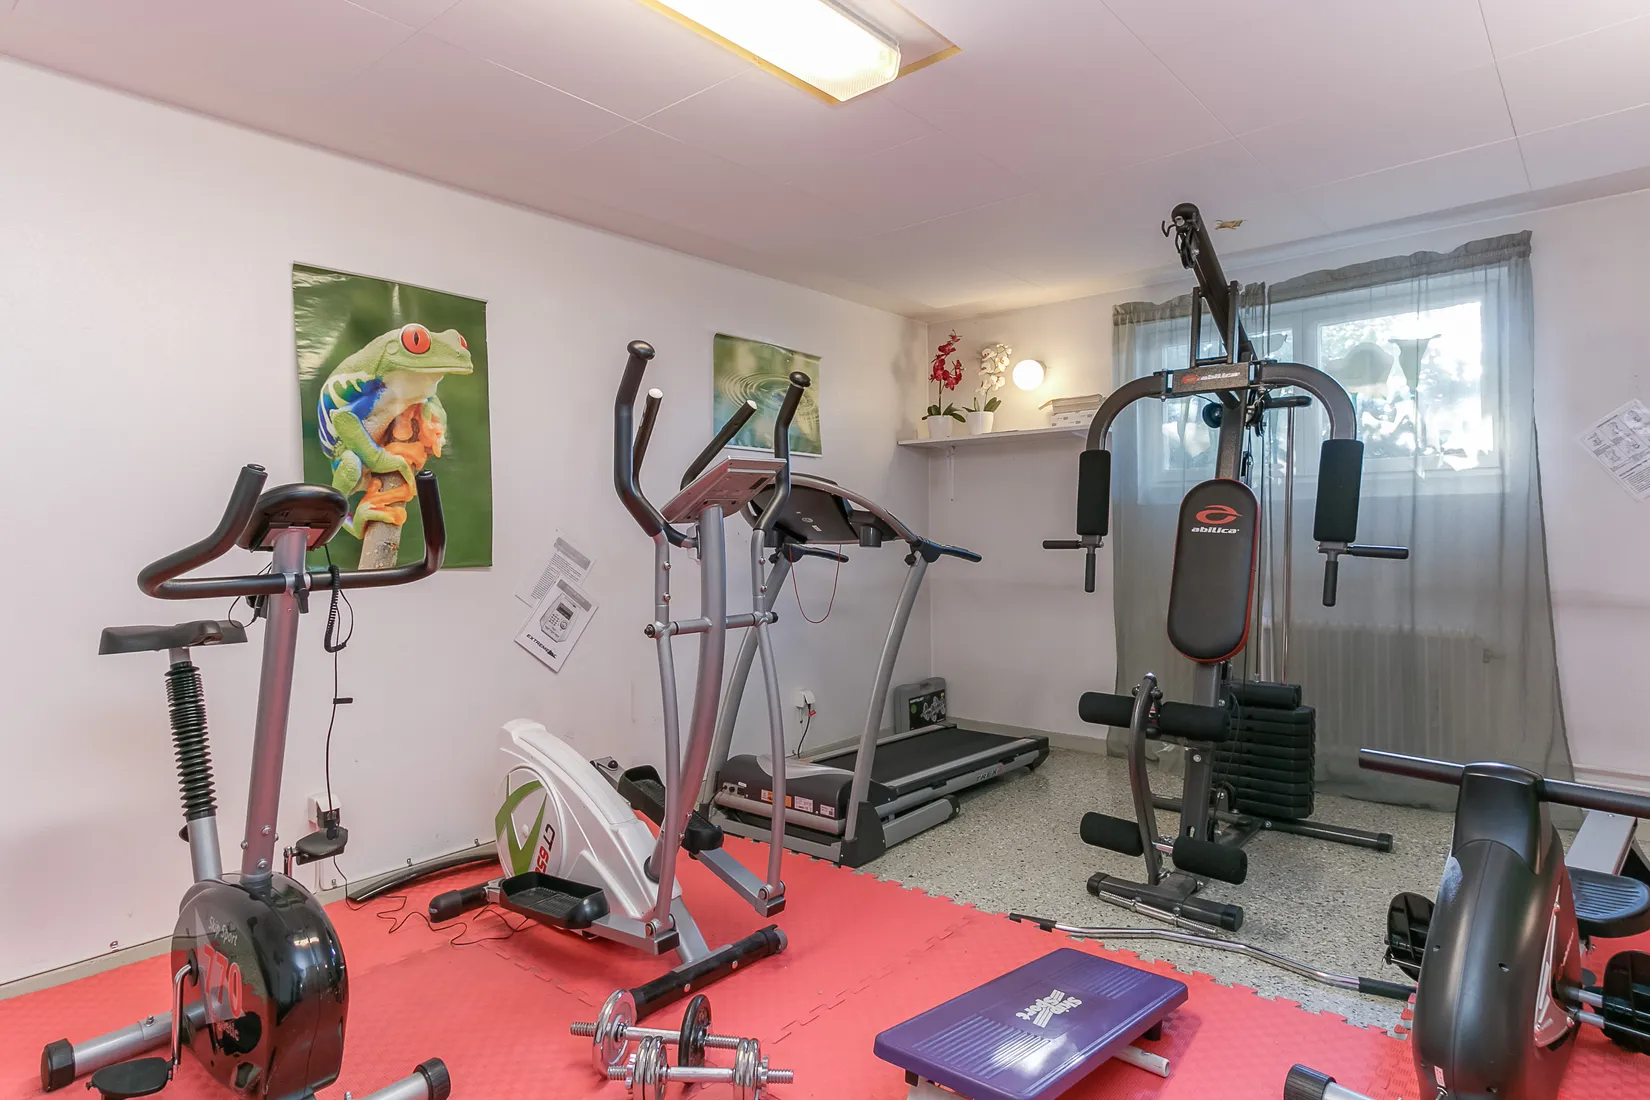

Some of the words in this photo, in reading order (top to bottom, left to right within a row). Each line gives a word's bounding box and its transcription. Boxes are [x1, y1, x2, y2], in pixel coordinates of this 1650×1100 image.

[1198, 371, 1240, 381] abilica
[1191, 526, 1239, 534] abilica
[543, 823, 556, 852] CT
[203, 943, 243, 1018] 770
